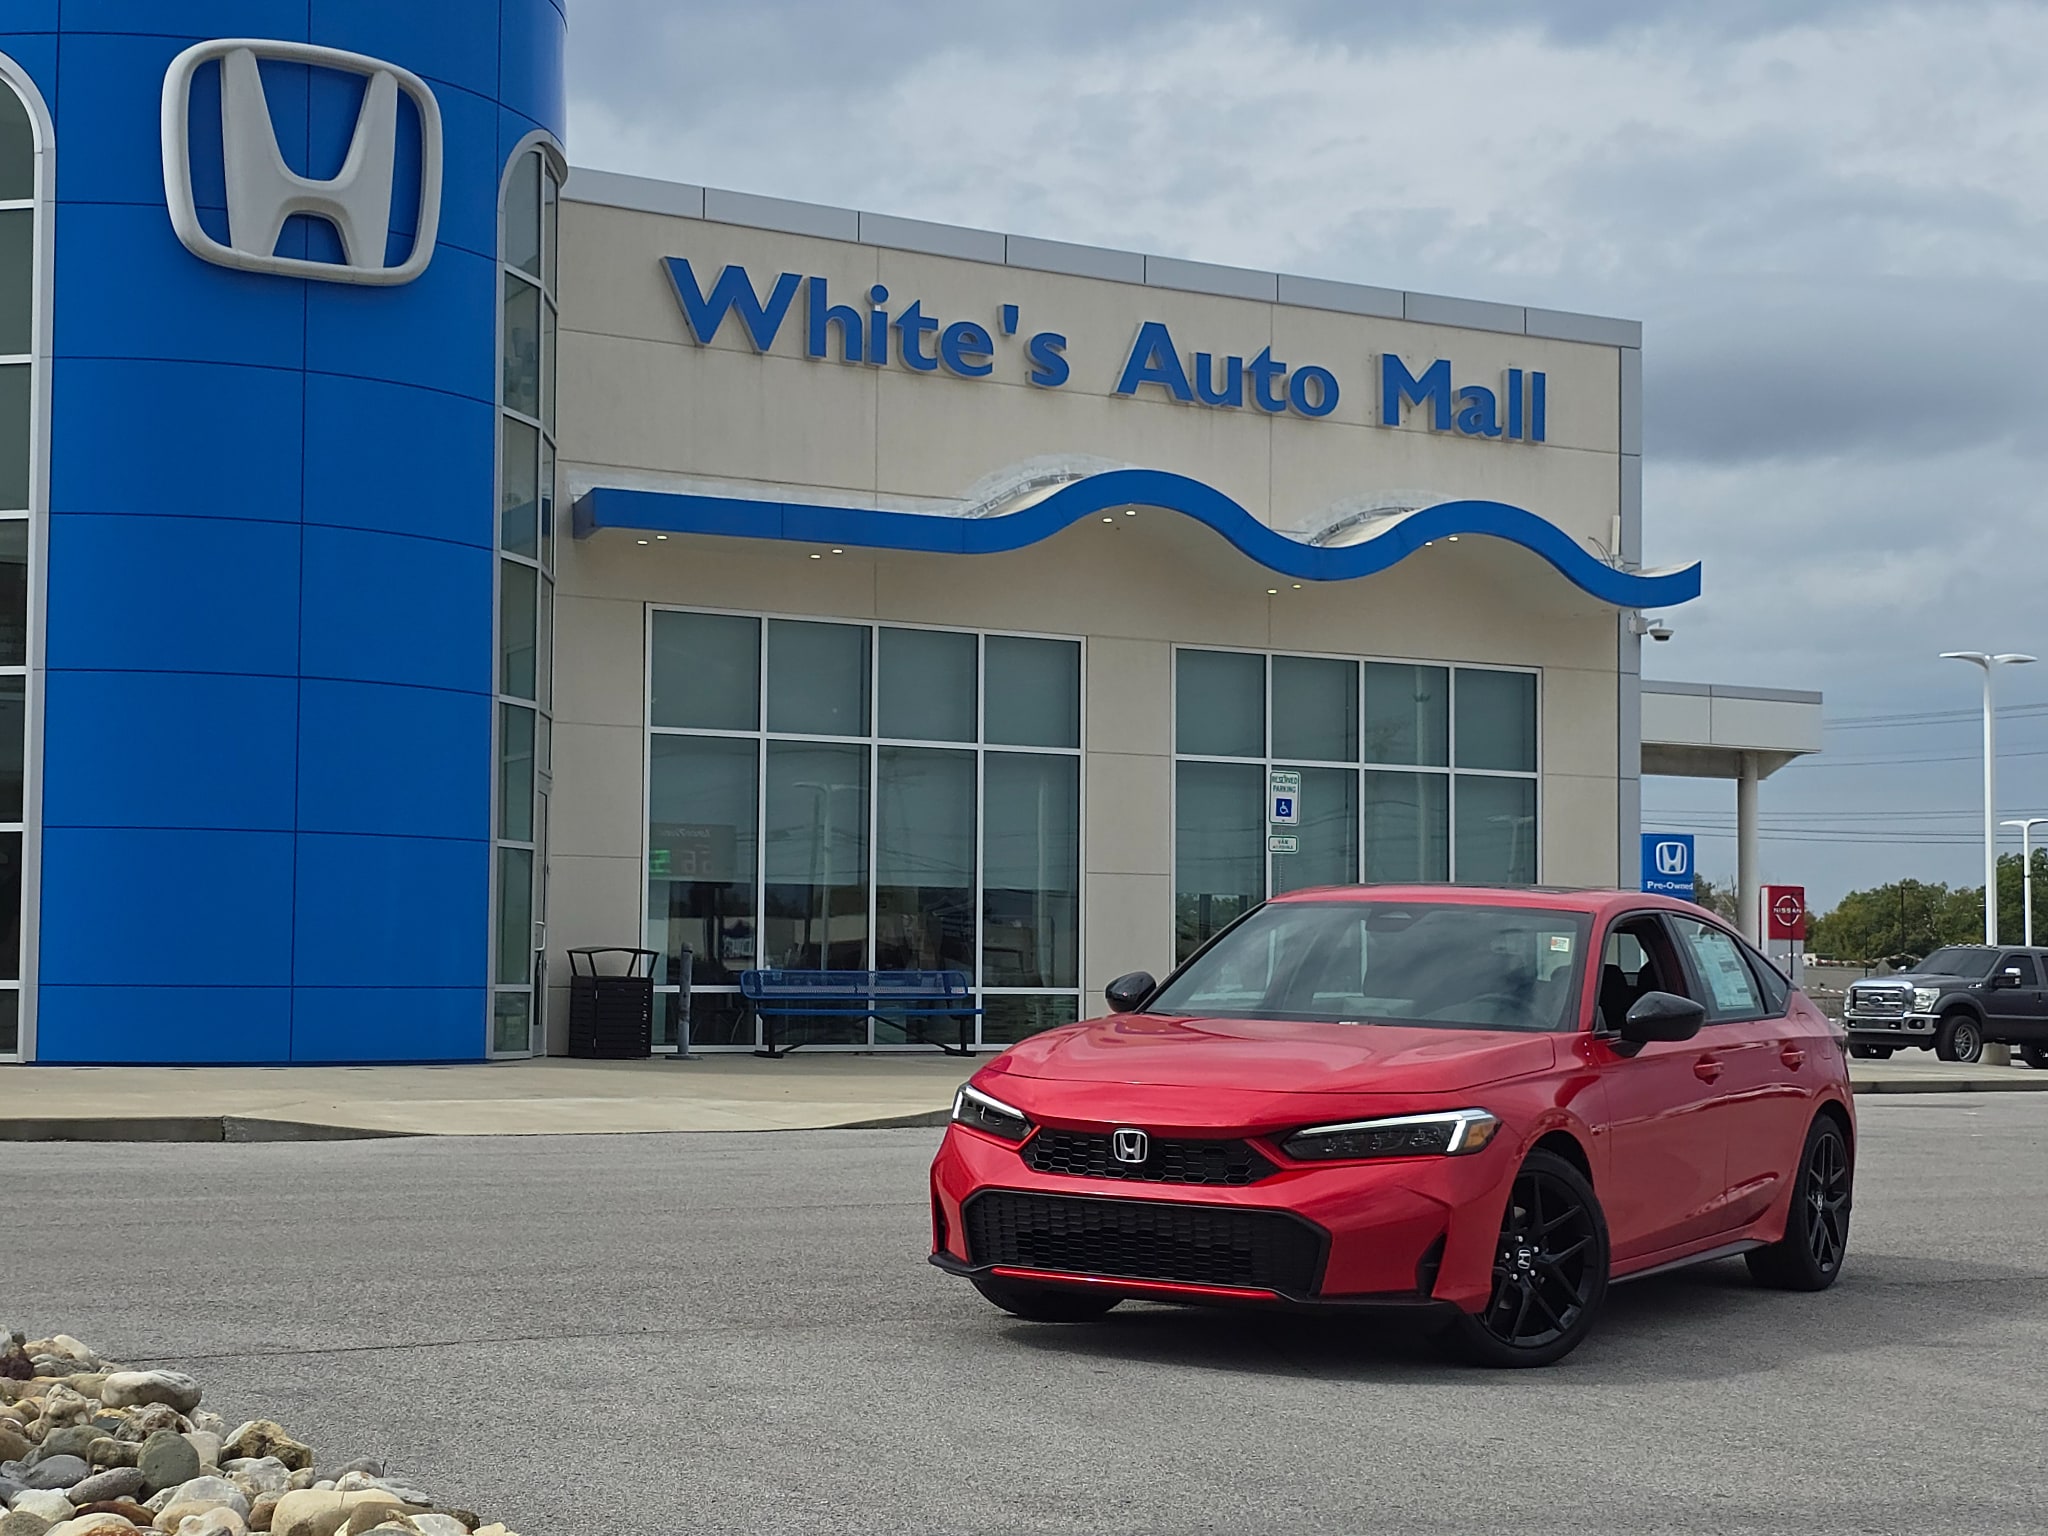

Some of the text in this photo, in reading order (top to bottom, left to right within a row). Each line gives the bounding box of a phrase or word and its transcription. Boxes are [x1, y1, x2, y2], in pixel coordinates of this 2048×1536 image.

[659, 255, 1546, 442] White's Auto Mall
[1273, 785, 1297, 793] PARKING
[1647, 881, 1694, 890] Pre-Owned
